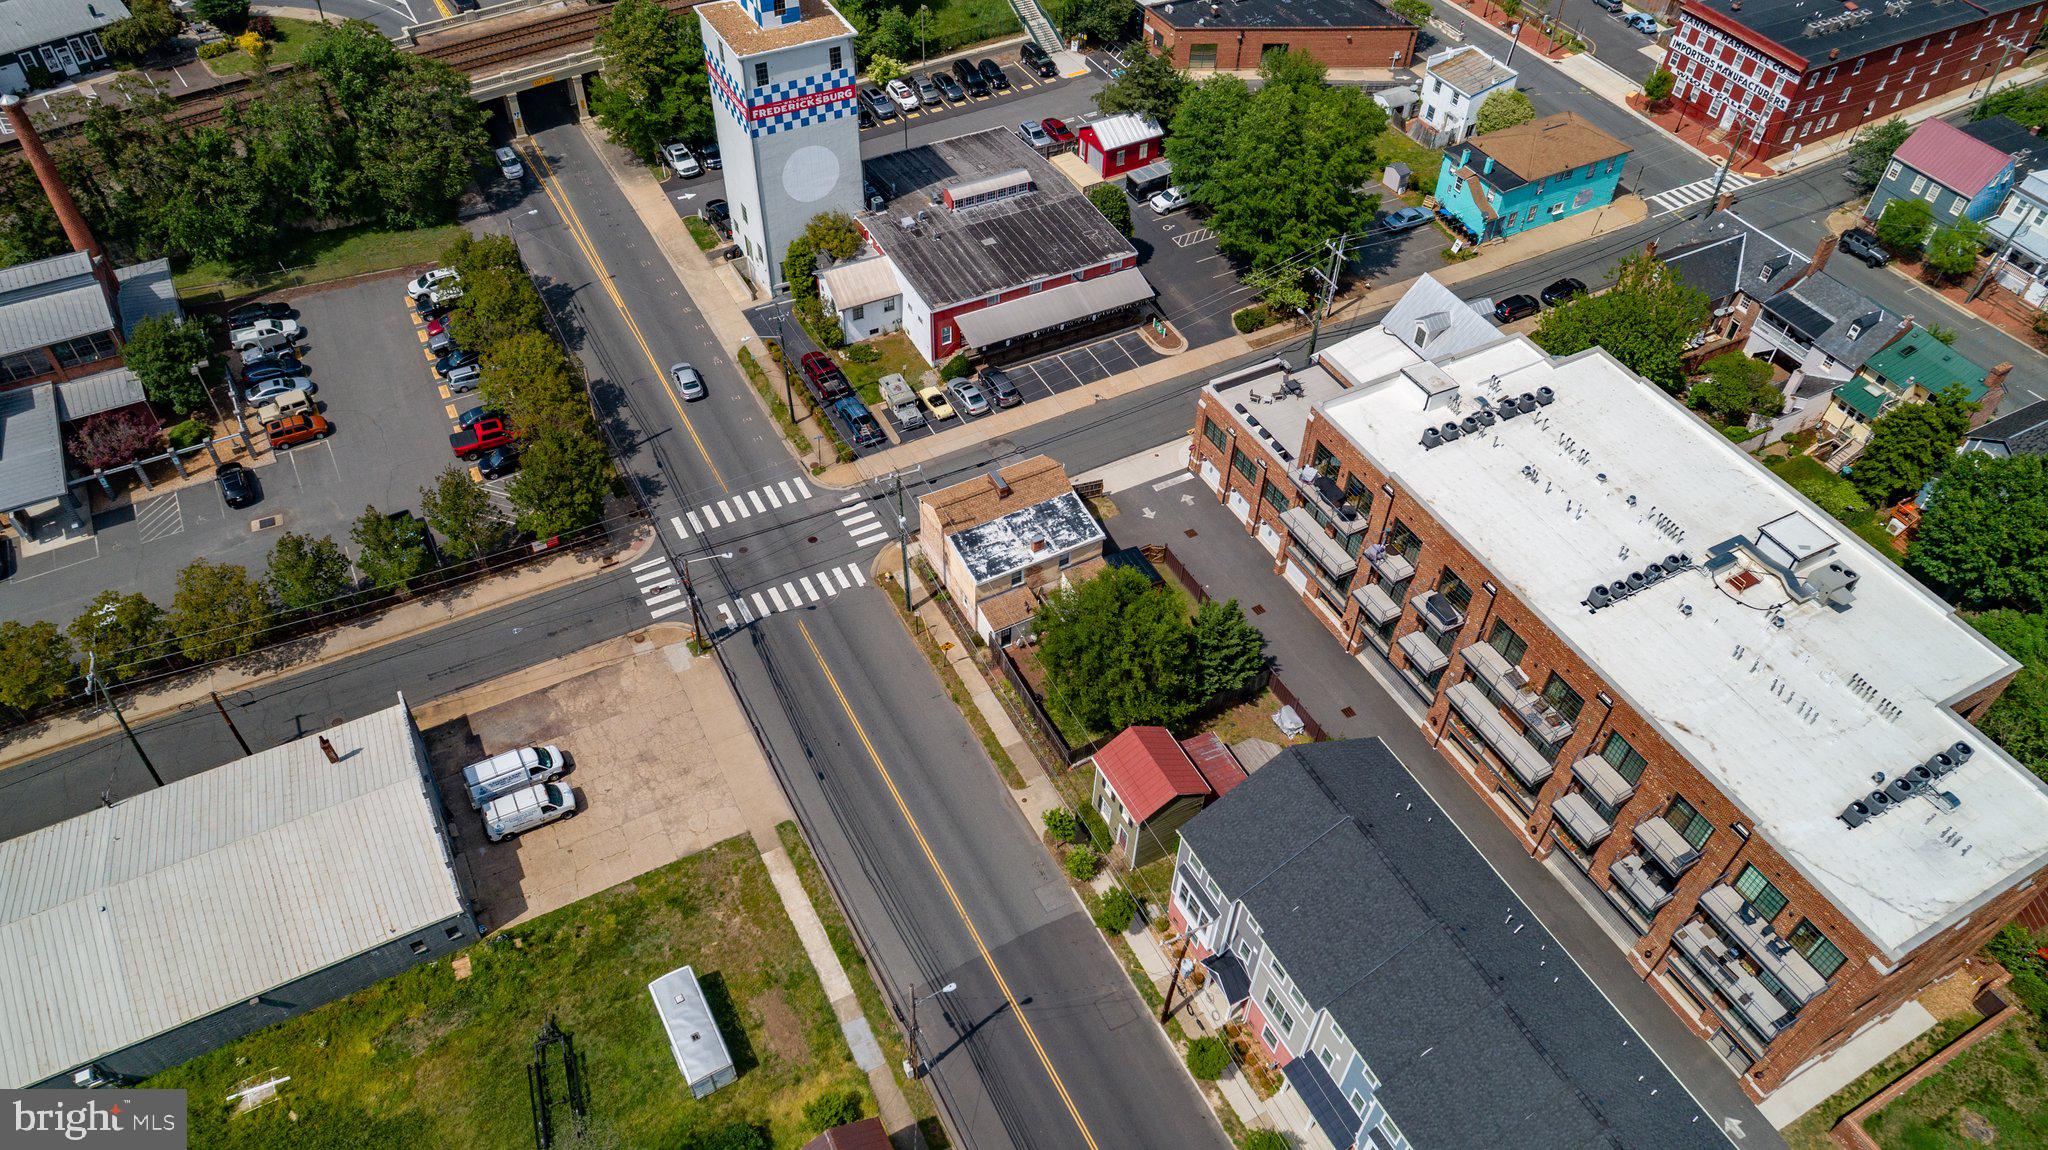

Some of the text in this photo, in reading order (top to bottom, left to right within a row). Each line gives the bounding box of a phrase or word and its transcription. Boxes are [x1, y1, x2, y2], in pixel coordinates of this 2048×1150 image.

[1672, 39, 1715, 68] IMPORTERS
[1682, 15, 1718, 36] JANNEY
[1720, 34, 1770, 67] MARSHALL
[752, 88, 853, 119] FREDERICKSBURG
[783, 94, 813, 105] WELCOME
[1676, 70, 1761, 121] WHOLESALERS
